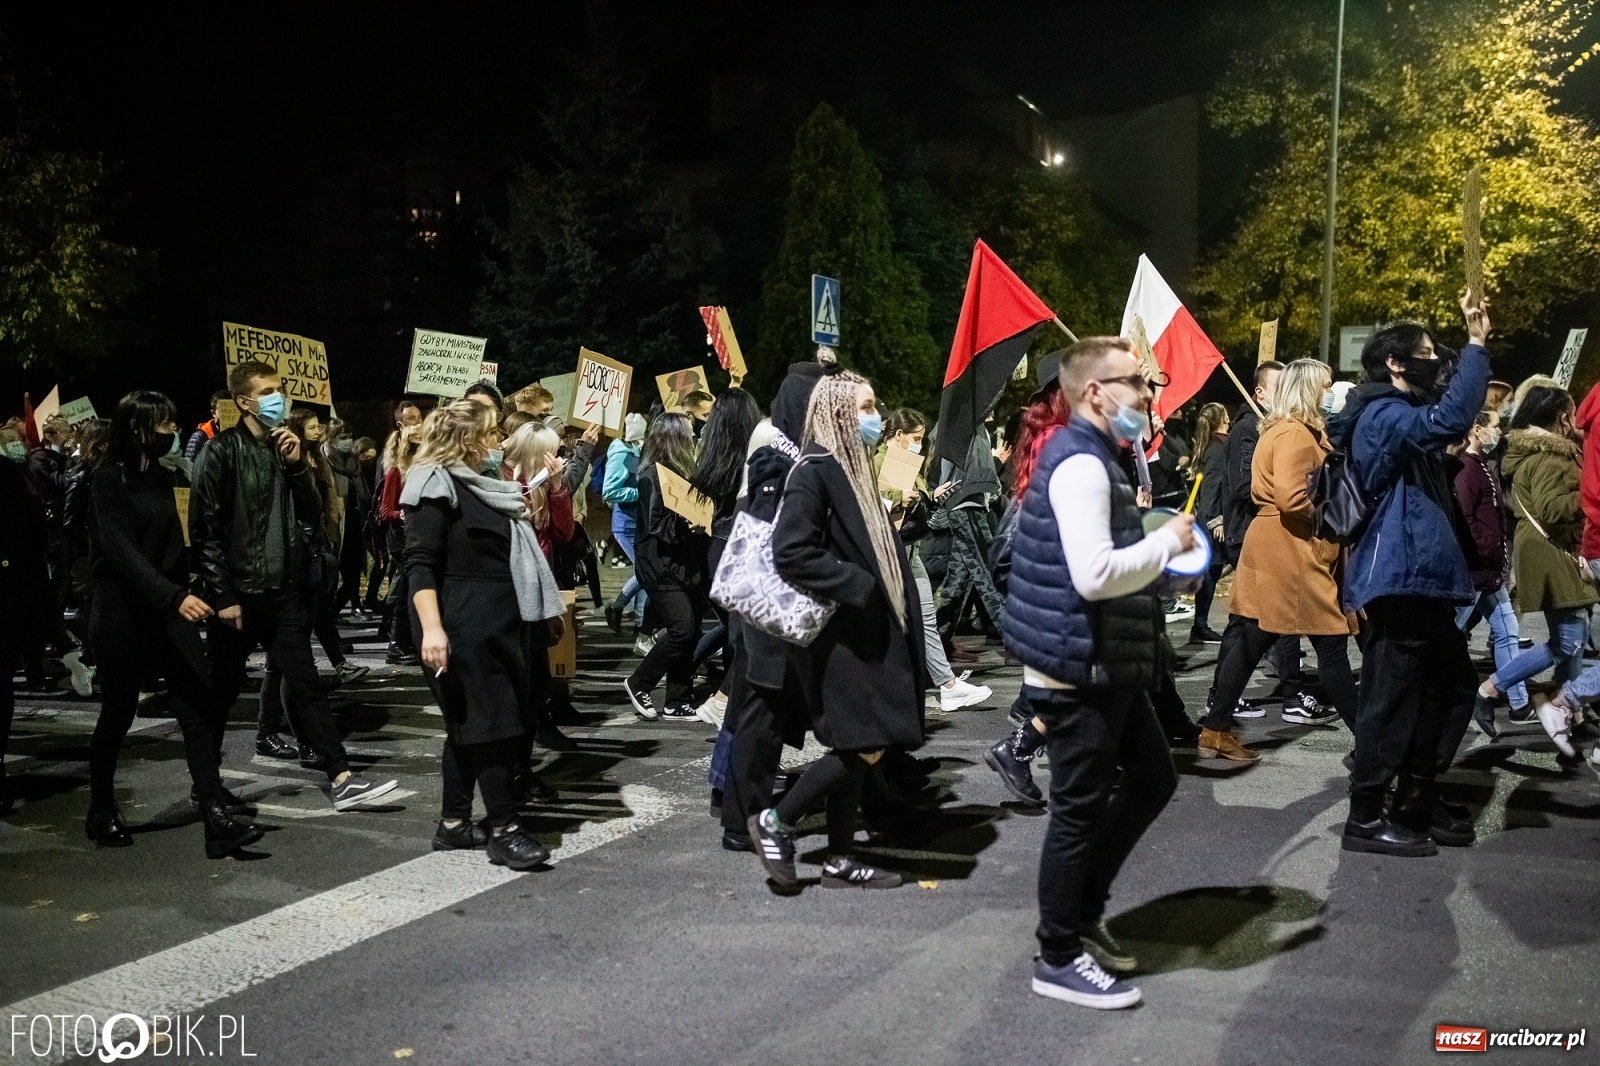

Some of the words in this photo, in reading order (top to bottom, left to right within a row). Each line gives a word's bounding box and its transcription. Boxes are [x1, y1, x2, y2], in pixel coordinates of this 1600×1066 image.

[226, 325, 302, 357] MEFEDRON
[419, 334, 446, 347] GDYBY
[287, 358, 329, 381] SKŁAD
[415, 361, 443, 374] ABORCJA
[418, 373, 468, 388] SAKRAMENTEM
